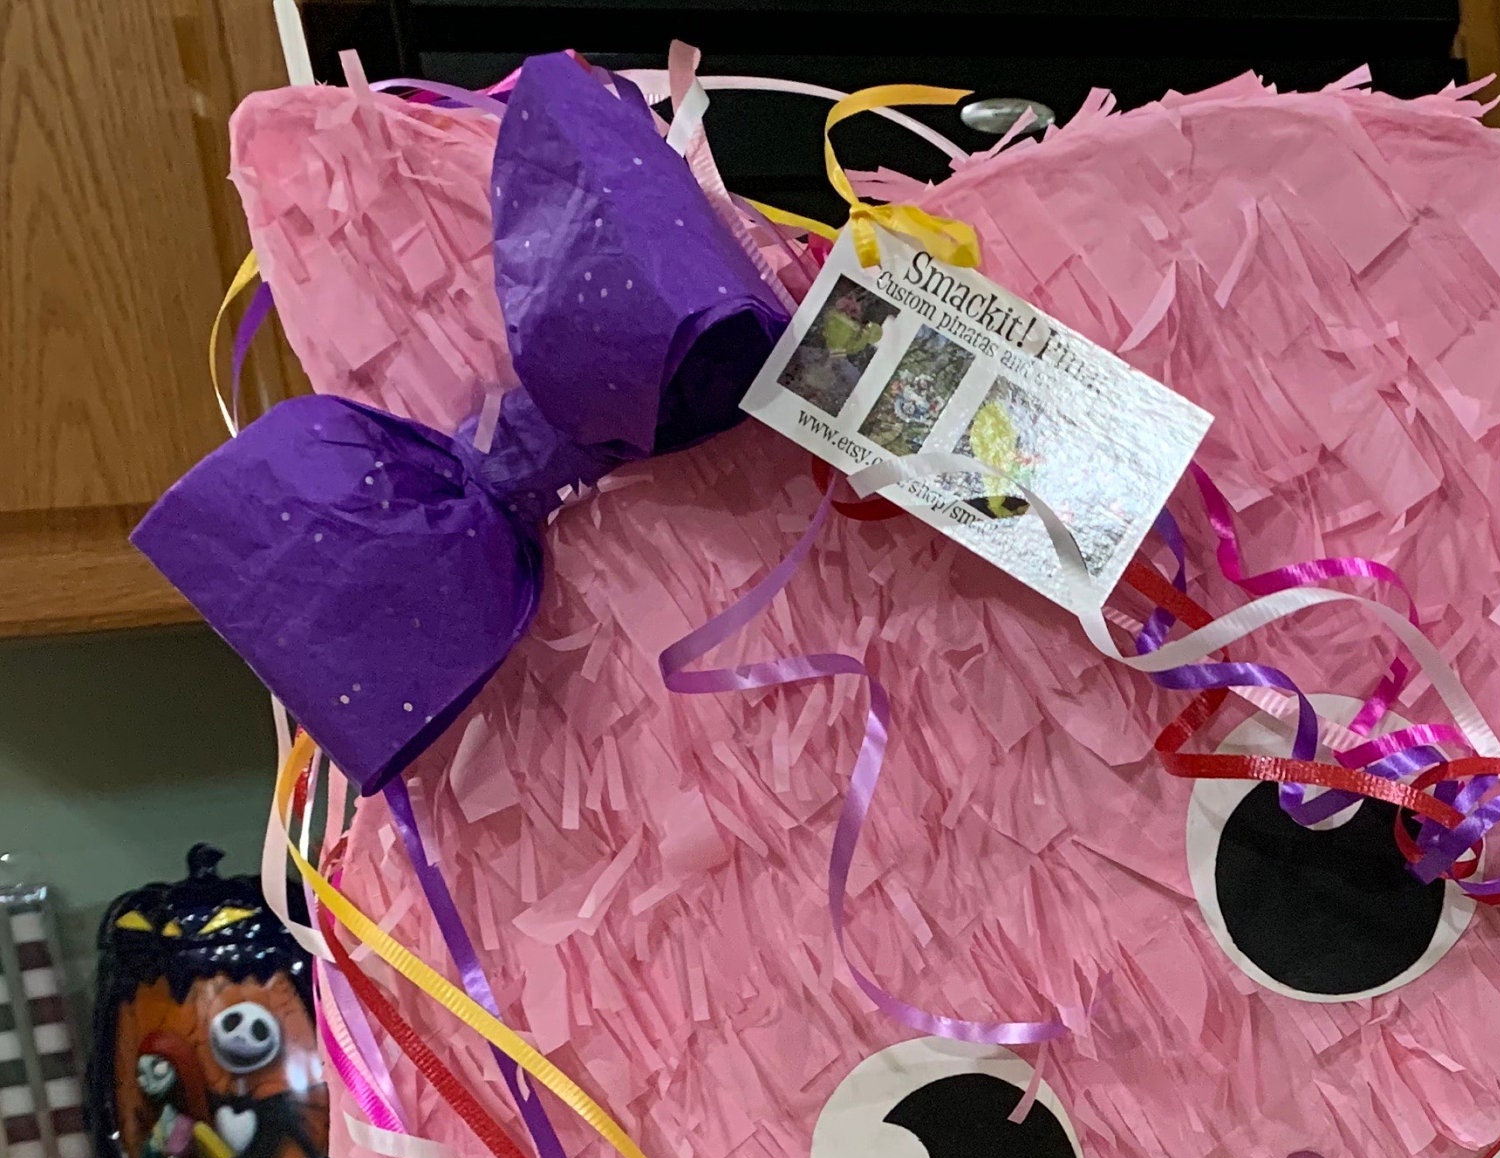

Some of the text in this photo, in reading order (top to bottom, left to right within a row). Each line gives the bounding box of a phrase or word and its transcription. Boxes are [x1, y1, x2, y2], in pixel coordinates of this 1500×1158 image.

[876, 270, 937, 322] Custom
[935, 311, 1000, 358] pinatas
[903, 250, 1037, 349] Smackit!
